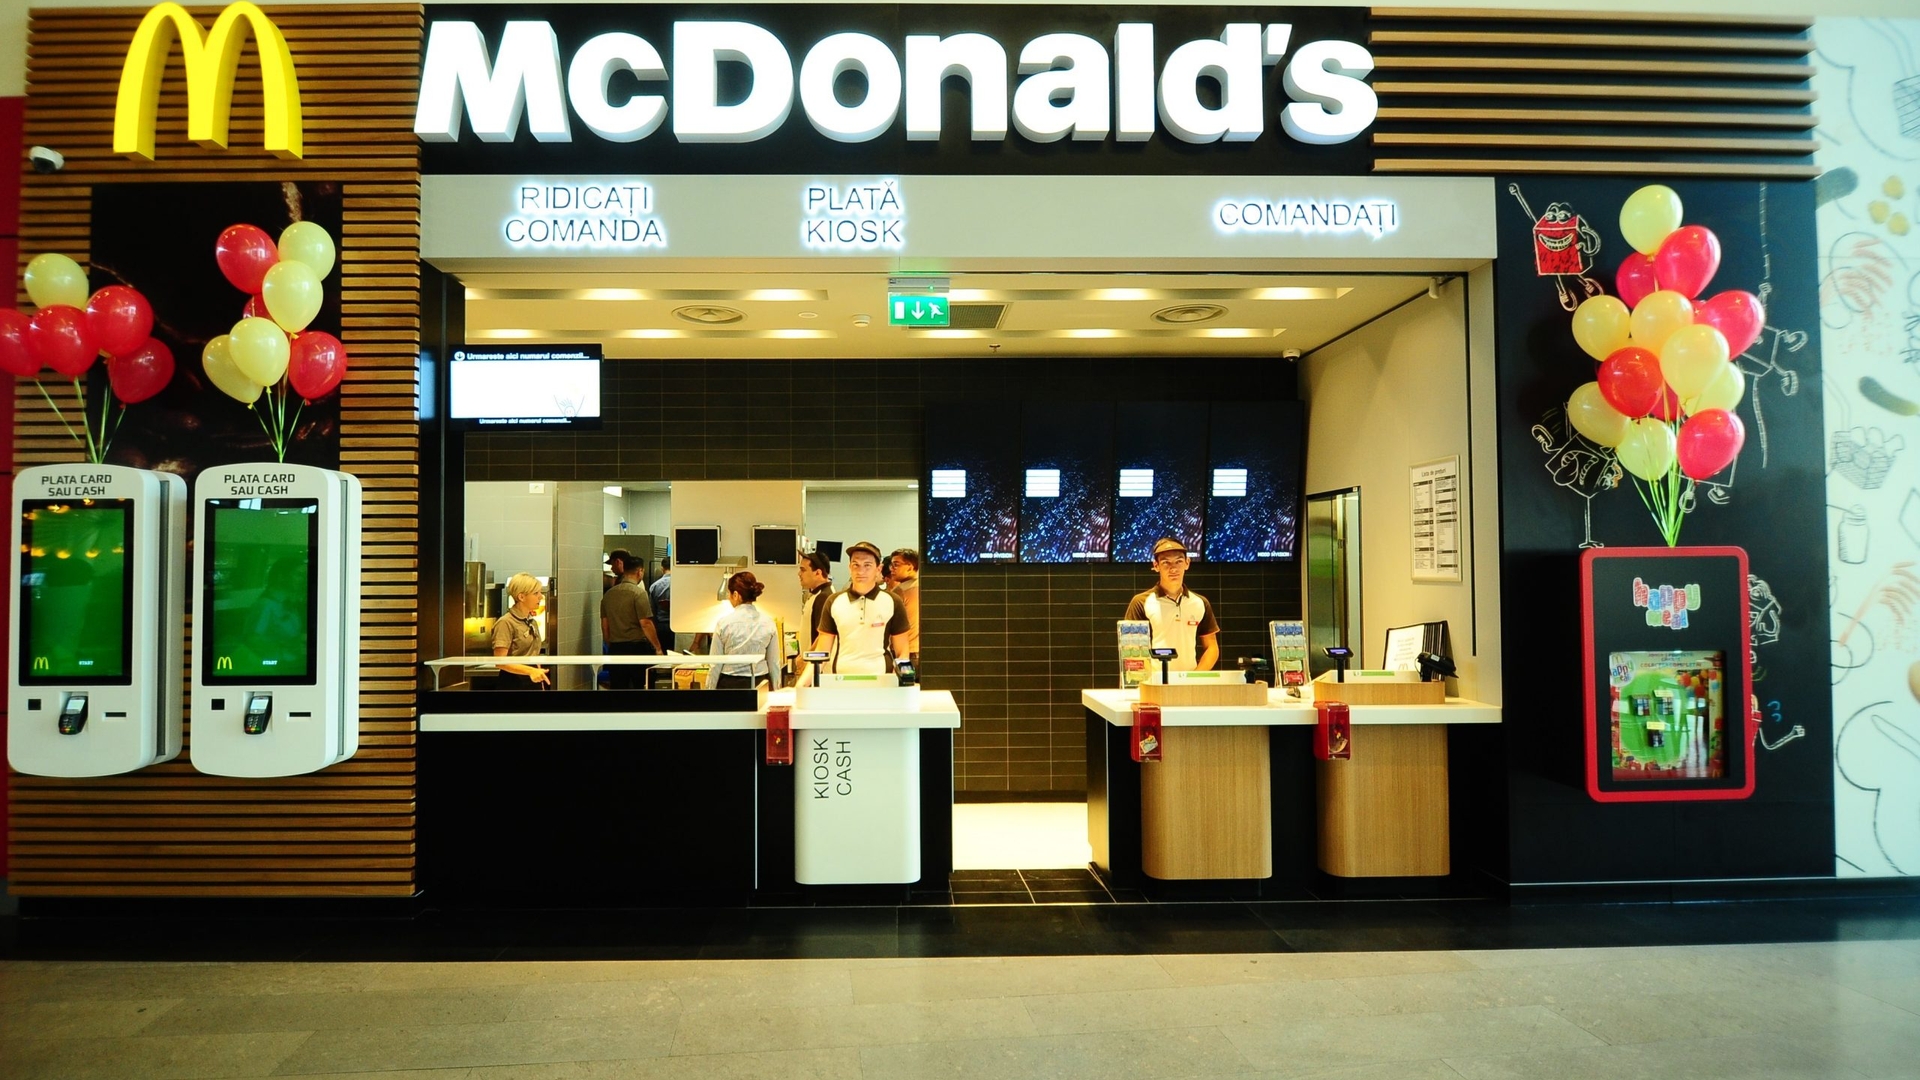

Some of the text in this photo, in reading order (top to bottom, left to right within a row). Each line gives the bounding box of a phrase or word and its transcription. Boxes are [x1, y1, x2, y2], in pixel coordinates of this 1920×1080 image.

[414, 20, 1378, 144] McDonald's
[808, 181, 900, 210] PLATĂ
[505, 219, 662, 242] COMANDA
[807, 219, 901, 243] KIOSK
[41, 473, 113, 486] PLATA CARD
[223, 472, 296, 485] PLATA CARD
[230, 484, 289, 496] SAU CASH
[48, 485, 106, 497] SAU CASH
[813, 737, 830, 800] KIOSK
[836, 740, 852, 797] CASH
